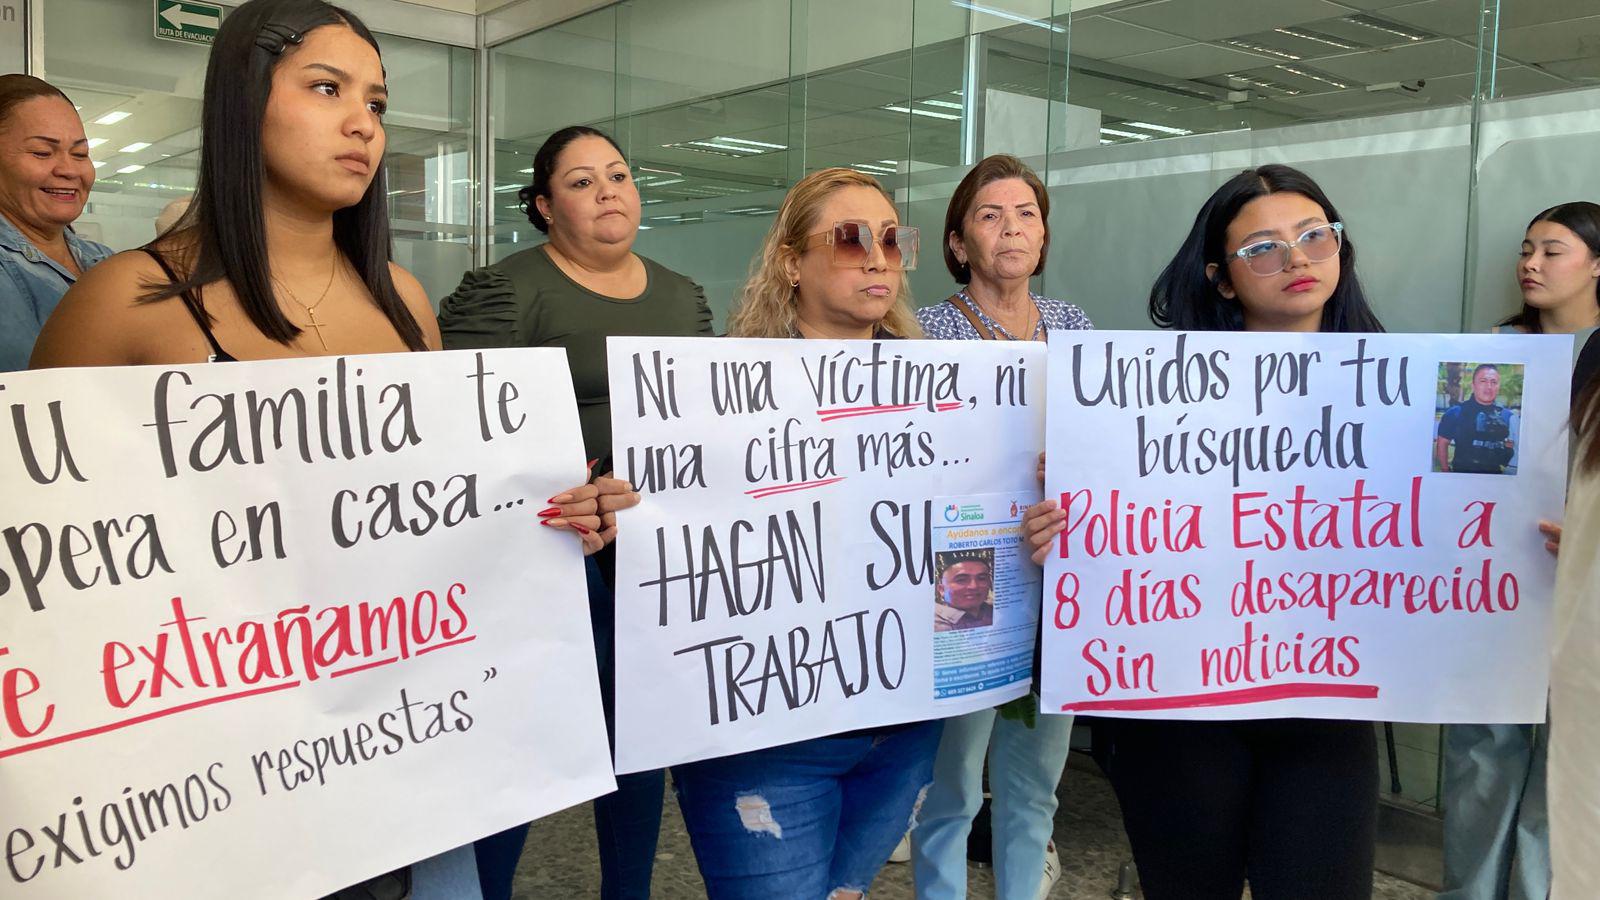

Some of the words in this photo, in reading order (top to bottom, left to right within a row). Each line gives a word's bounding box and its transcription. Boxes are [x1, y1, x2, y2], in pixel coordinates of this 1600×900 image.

[159, 27, 175, 36] RUTA
[175, 30, 183, 38] DE
[632, 350, 681, 421] Ni
[710, 360, 779, 416] una
[801, 342, 978, 413] víctima,
[995, 357, 1028, 407] ni
[1072, 333, 1229, 408] Unidos
[1254, 349, 1321, 416] por
[1340, 338, 1411, 407] tu
[0, 384, 88, 485] u
[143, 357, 422, 478] familia
[466, 352, 527, 442] te
[627, 444, 708, 494] una
[744, 417, 838, 483] cifra
[857, 420, 971, 478] más...
[1137, 405, 1368, 488] búsqueda
[0, 513, 176, 613] pera
[211, 502, 287, 569] en
[331, 473, 525, 550] casa...
[948, 539, 978, 549] ROBERTO
[980, 538, 1002, 547] CARLOS
[1003, 537, 1018, 545] TOTO
[960, 512, 984, 521] Sinaloa
[1059, 488, 1207, 559] Policia
[1233, 476, 1424, 552] Estatal
[1457, 500, 1496, 549] a
[639, 500, 825, 627] HAGAN
[866, 499, 935, 591] SU
[1054, 573, 1080, 631] 8
[1105, 568, 1202, 626] días
[1231, 558, 1519, 621] desaparecido
[0, 646, 56, 739] e
[100, 581, 468, 710] extrañamos
[673, 607, 907, 726] TRABAJO
[1081, 638, 1158, 698] Sin
[1201, 621, 1361, 688] noticias
[5, 762, 232, 884] exigimos
